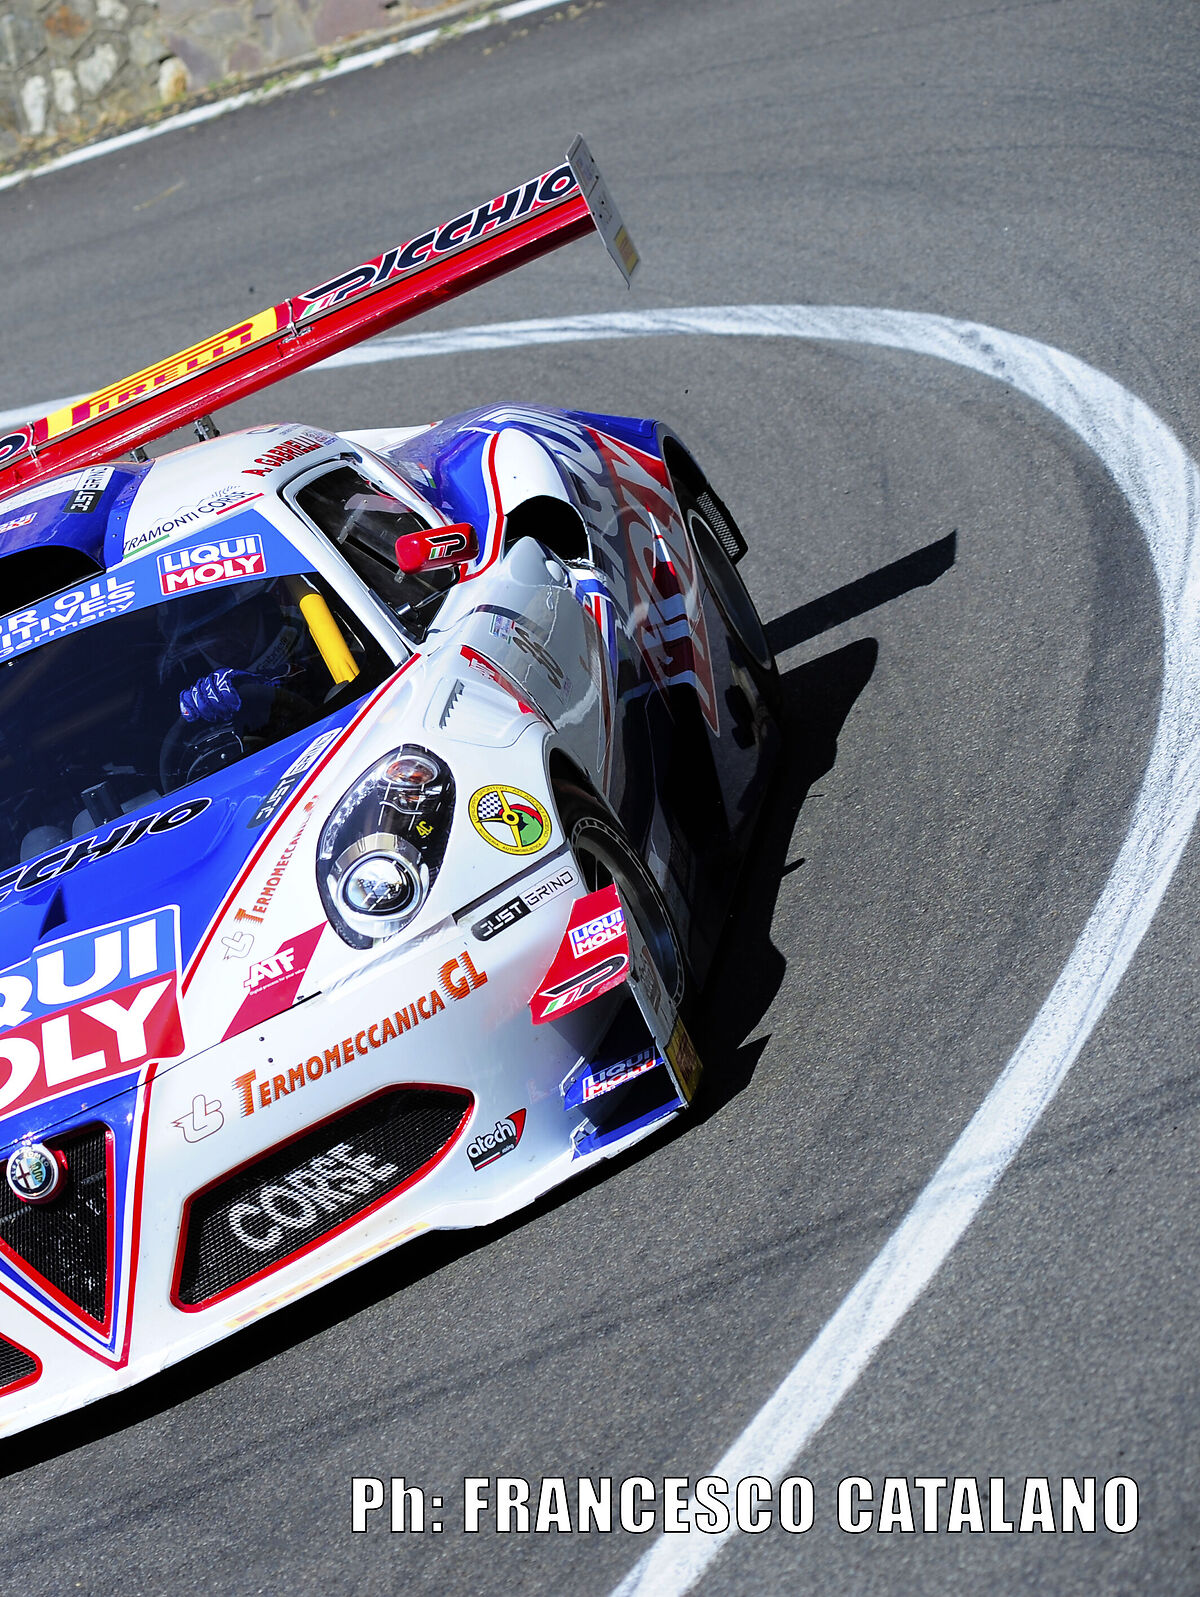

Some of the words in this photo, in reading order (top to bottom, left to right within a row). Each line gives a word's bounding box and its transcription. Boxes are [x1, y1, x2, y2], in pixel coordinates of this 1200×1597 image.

[298, 162, 581, 306] PICCHIO
[72, 322, 254, 426] PIRELLI
[253, 434, 325, 468] GABRIELLI
[163, 536, 257, 572] LIQUI
[164, 553, 263, 594] MOLY
[54, 576, 135, 611] OIL
[480, 901, 522, 937] JUST
[525, 870, 575, 907] GRIND
[573, 909, 624, 944] LIQUI
[576, 921, 626, 955] MOLY
[243, 946, 296, 989] ATF
[232, 990, 446, 1118] TERMOMECCANICA
[437, 950, 489, 1003] GL
[587, 1050, 650, 1086] LIQUI
[467, 1119, 517, 1158] atech
[227, 1141, 398, 1252] CORSE
